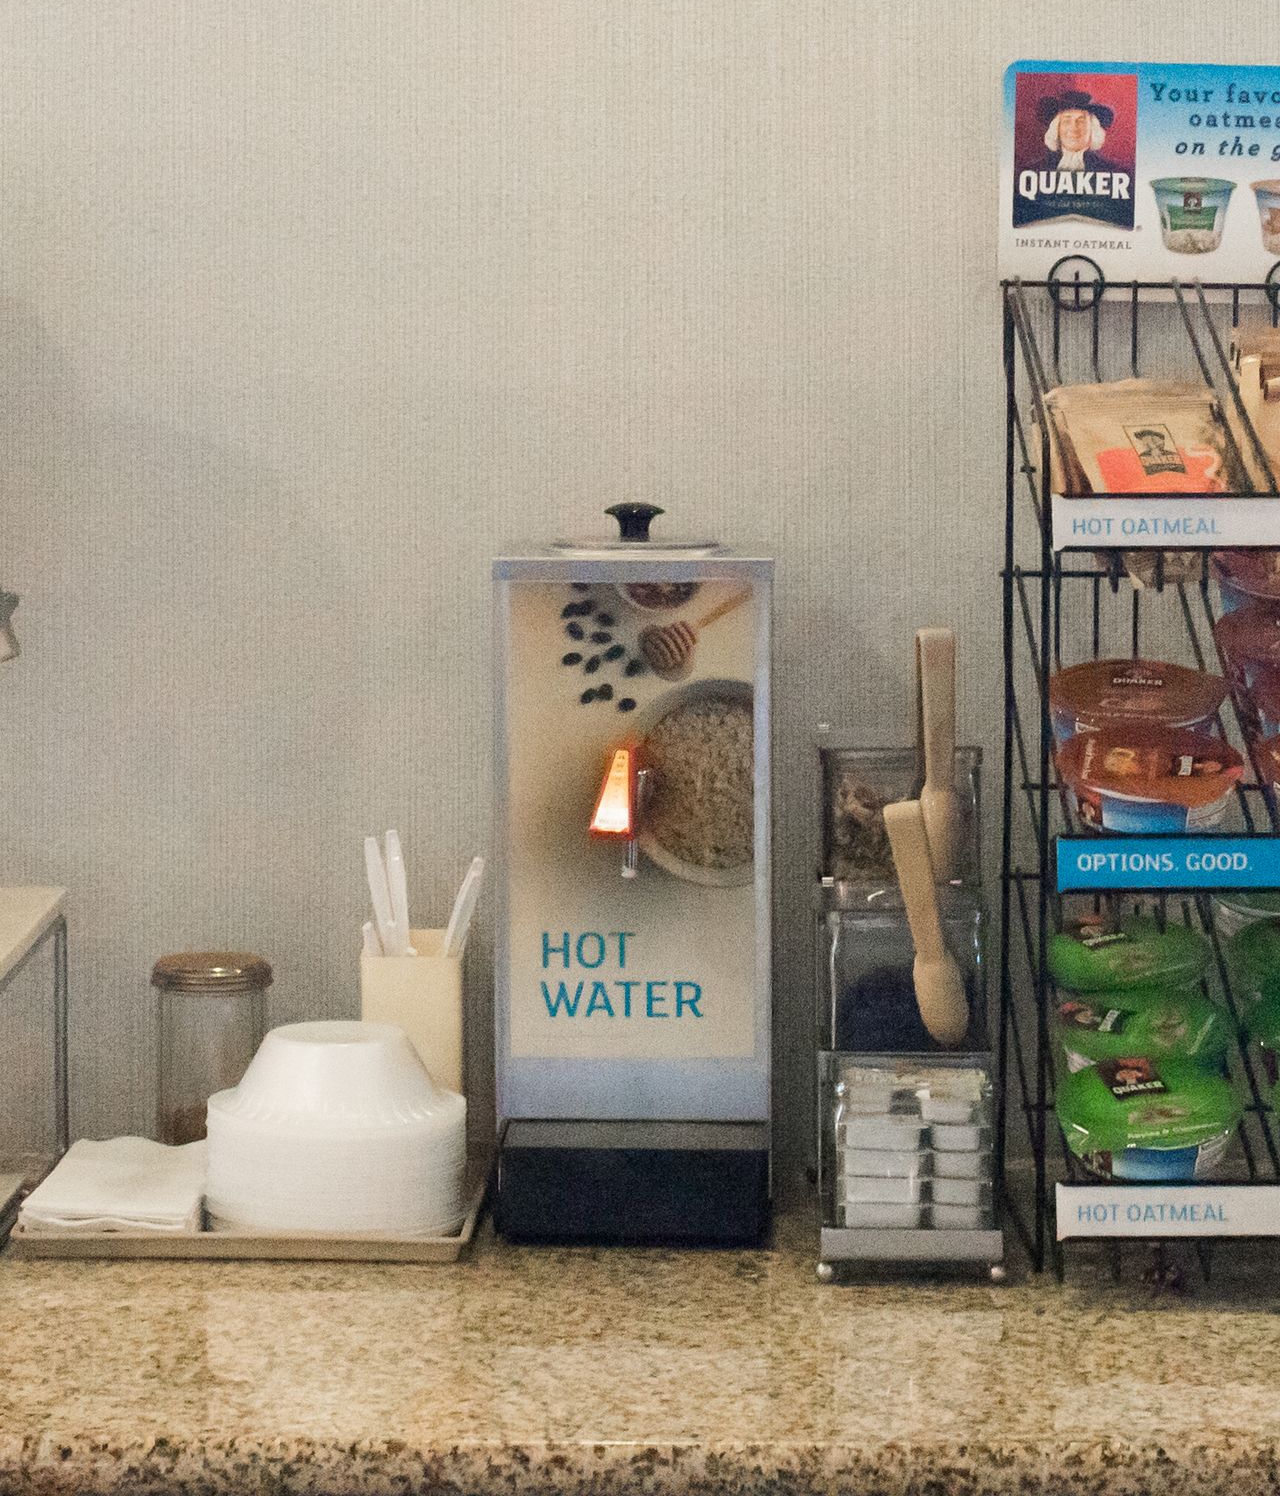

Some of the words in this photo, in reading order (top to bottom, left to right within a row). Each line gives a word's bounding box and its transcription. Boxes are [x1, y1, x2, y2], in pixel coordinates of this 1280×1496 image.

[1150, 83, 1214, 104] Your
[1175, 140, 1206, 155] on
[1218, 138, 1261, 156] the
[1019, 170, 1131, 201] QUAKER
[1015, 238, 1070, 249] INSTANT
[1073, 239, 1132, 250] OATMEAL
[1072, 517, 1113, 535] HOT
[1121, 517, 1222, 535] OATMEAL
[1077, 853, 1180, 872] OPTIONS.
[1186, 853, 1253, 871] GOOD.
[542, 931, 636, 970] HOT
[540, 981, 704, 1019] WATER
[1077, 1205, 1118, 1222] HOT
[1126, 1205, 1229, 1222] OATMEAL
